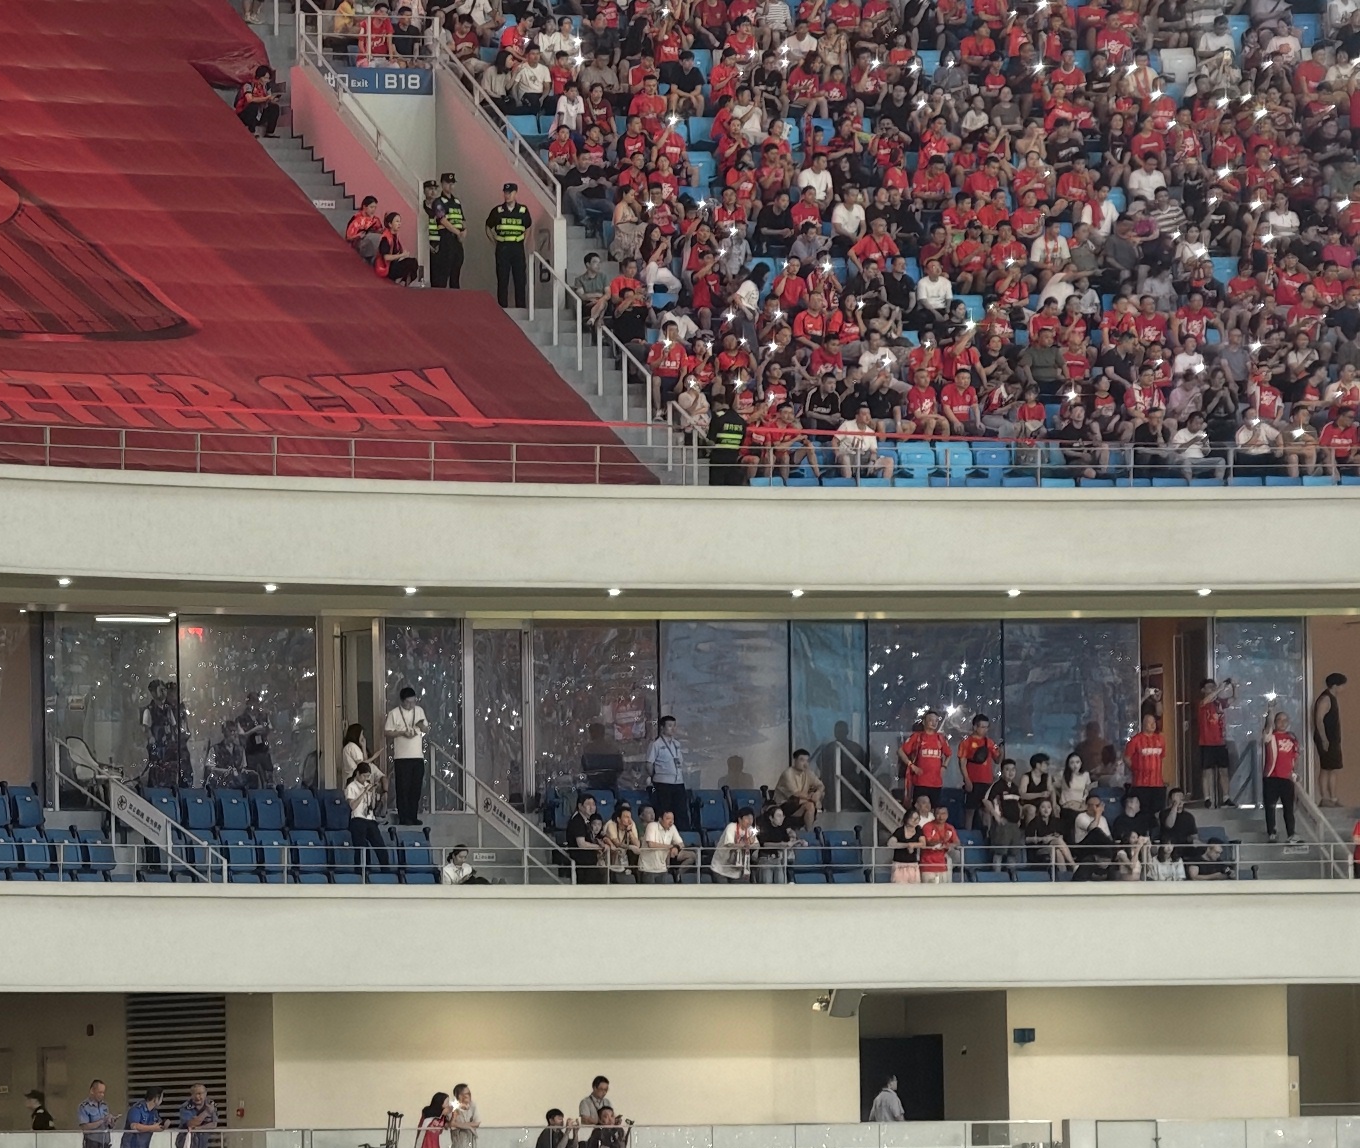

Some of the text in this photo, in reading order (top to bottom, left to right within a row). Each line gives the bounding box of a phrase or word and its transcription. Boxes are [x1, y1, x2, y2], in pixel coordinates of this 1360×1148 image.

[351, 79, 369, 89] Exit
[384, 74, 421, 90] B18
[253, 366, 494, 435] CITY
